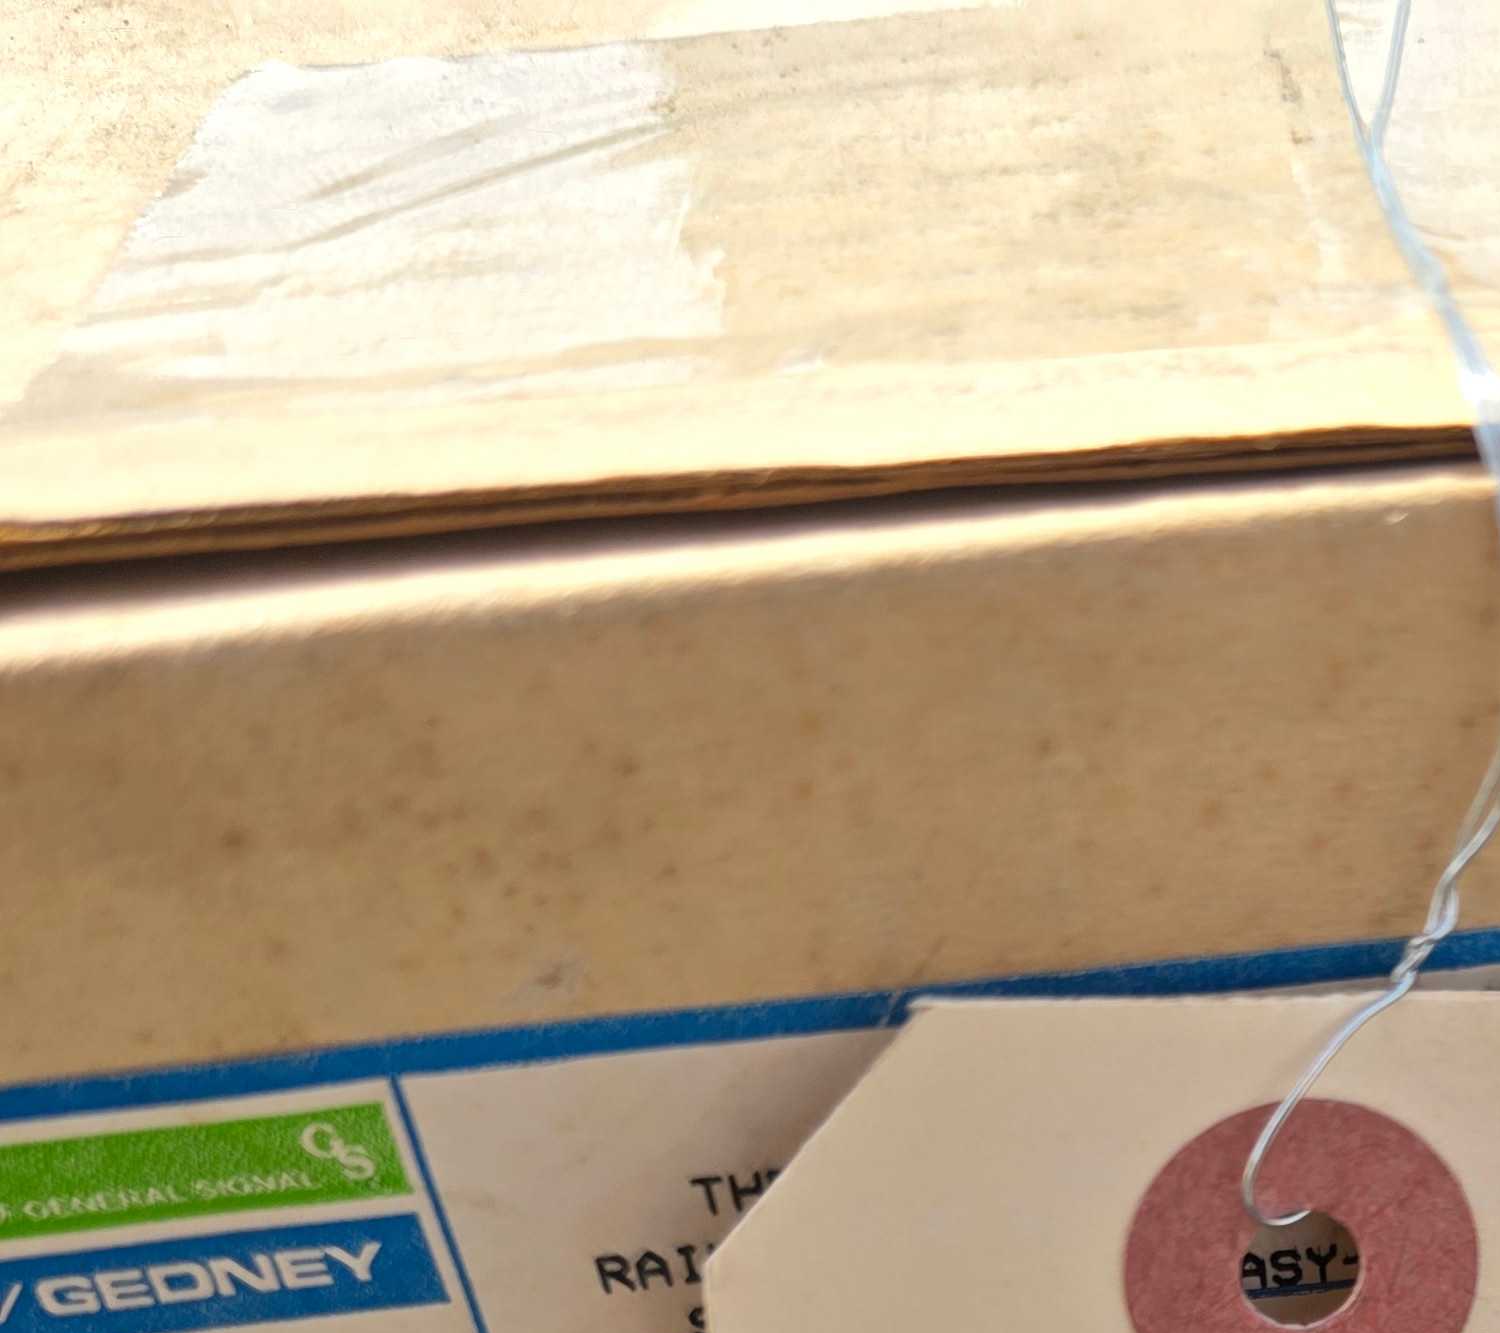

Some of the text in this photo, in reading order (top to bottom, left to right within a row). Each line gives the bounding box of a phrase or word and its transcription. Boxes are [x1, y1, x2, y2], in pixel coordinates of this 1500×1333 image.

[24, 1184, 187, 1220] GENERAL
[195, 1166, 322, 1200] SIGNAL
[690, 1170, 788, 1216] TH
[594, 1243, 716, 1294] RAI
